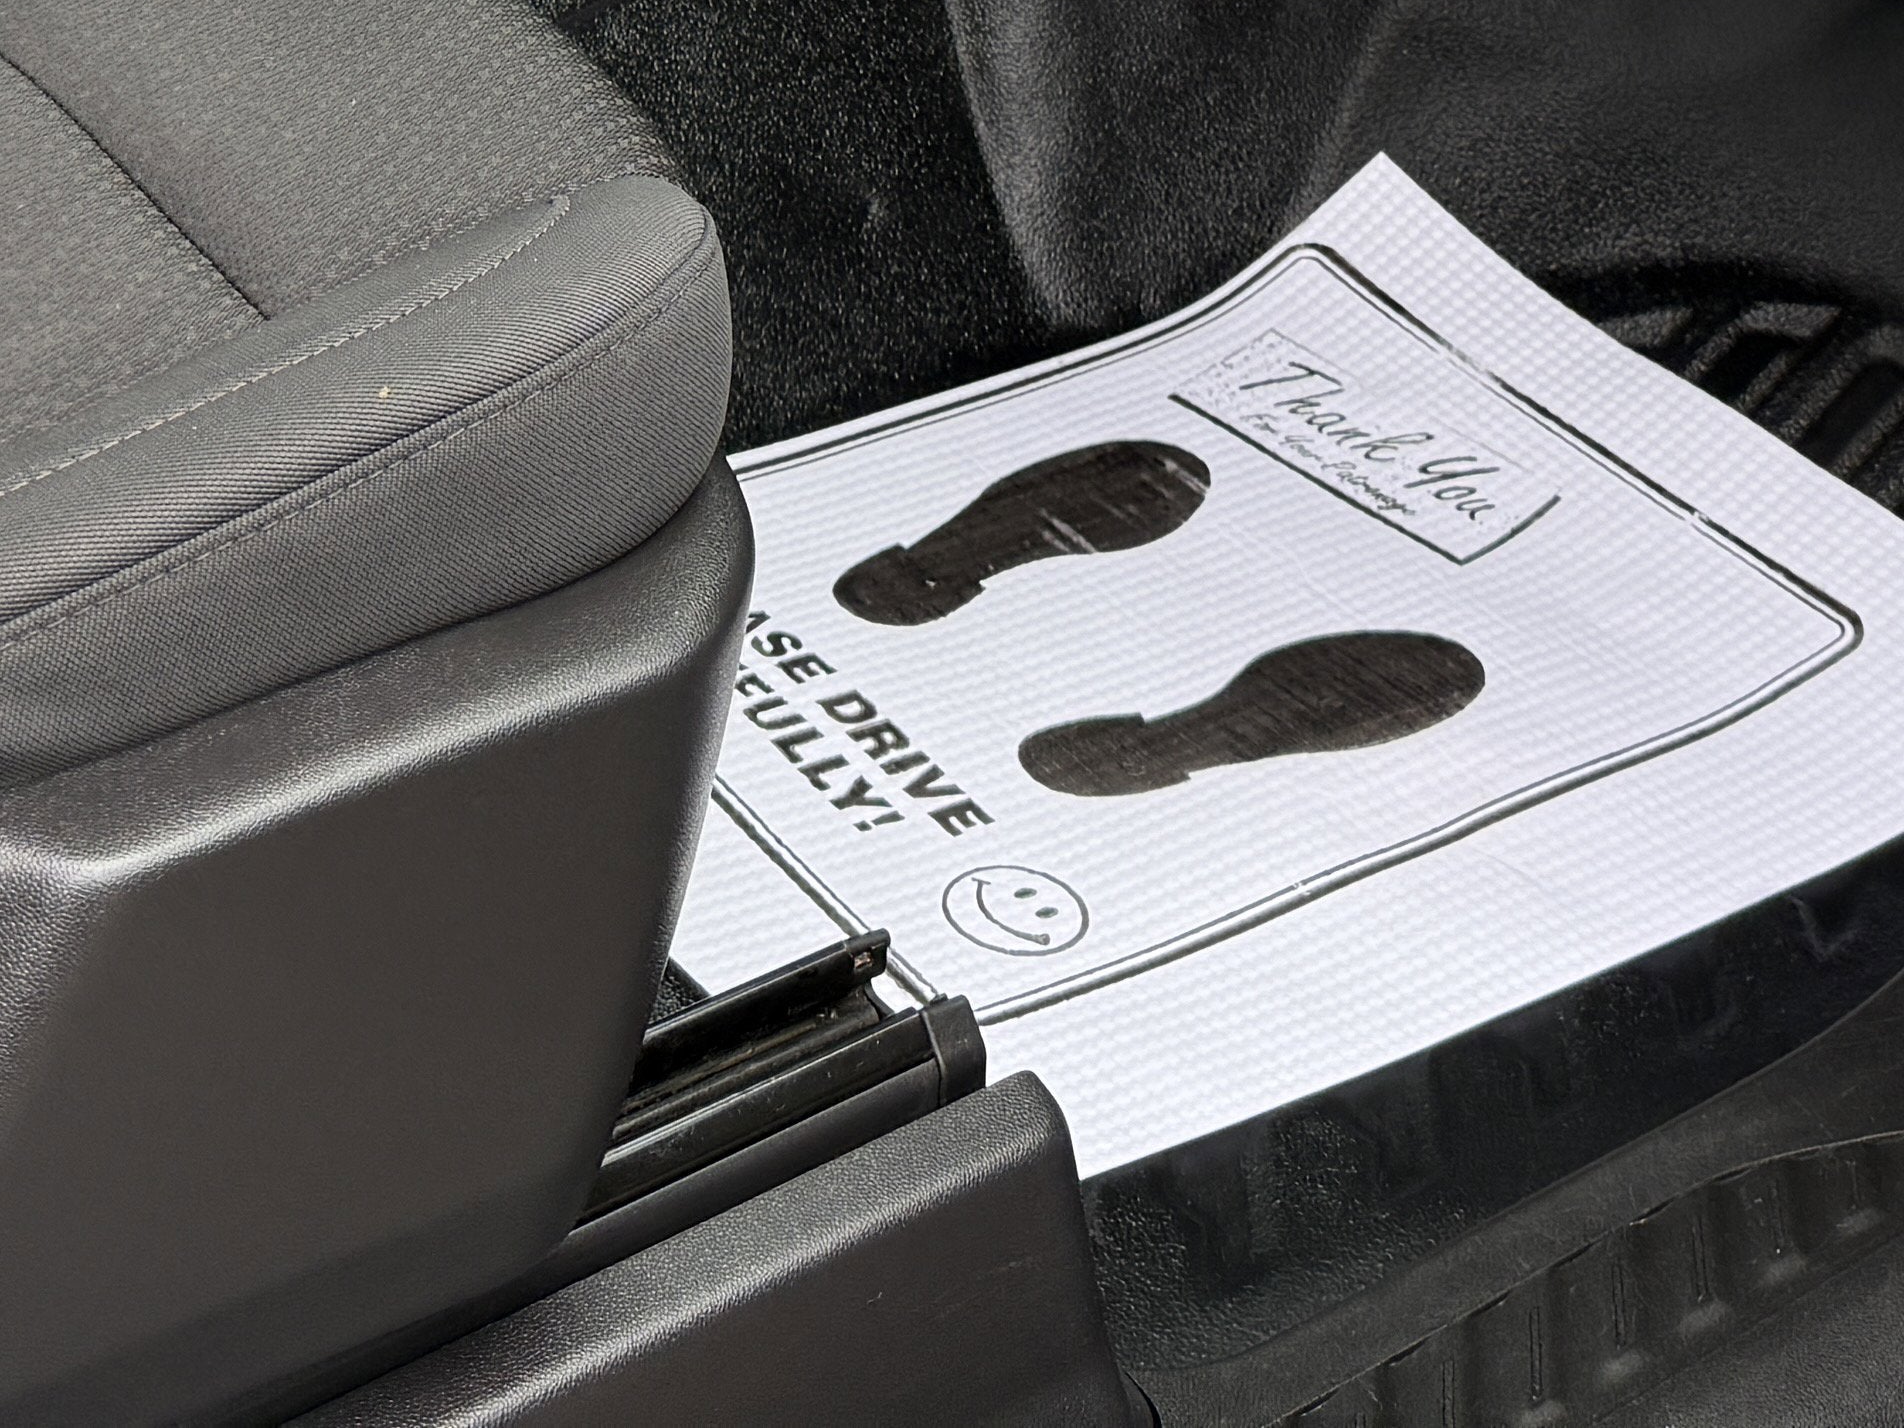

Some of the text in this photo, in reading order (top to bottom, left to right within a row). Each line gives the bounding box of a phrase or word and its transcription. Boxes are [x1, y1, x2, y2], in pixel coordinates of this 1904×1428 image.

[1239, 361, 1501, 522] Thank You
[734, 663, 905, 833] FULLY!
[815, 689, 996, 837] DRIVE
